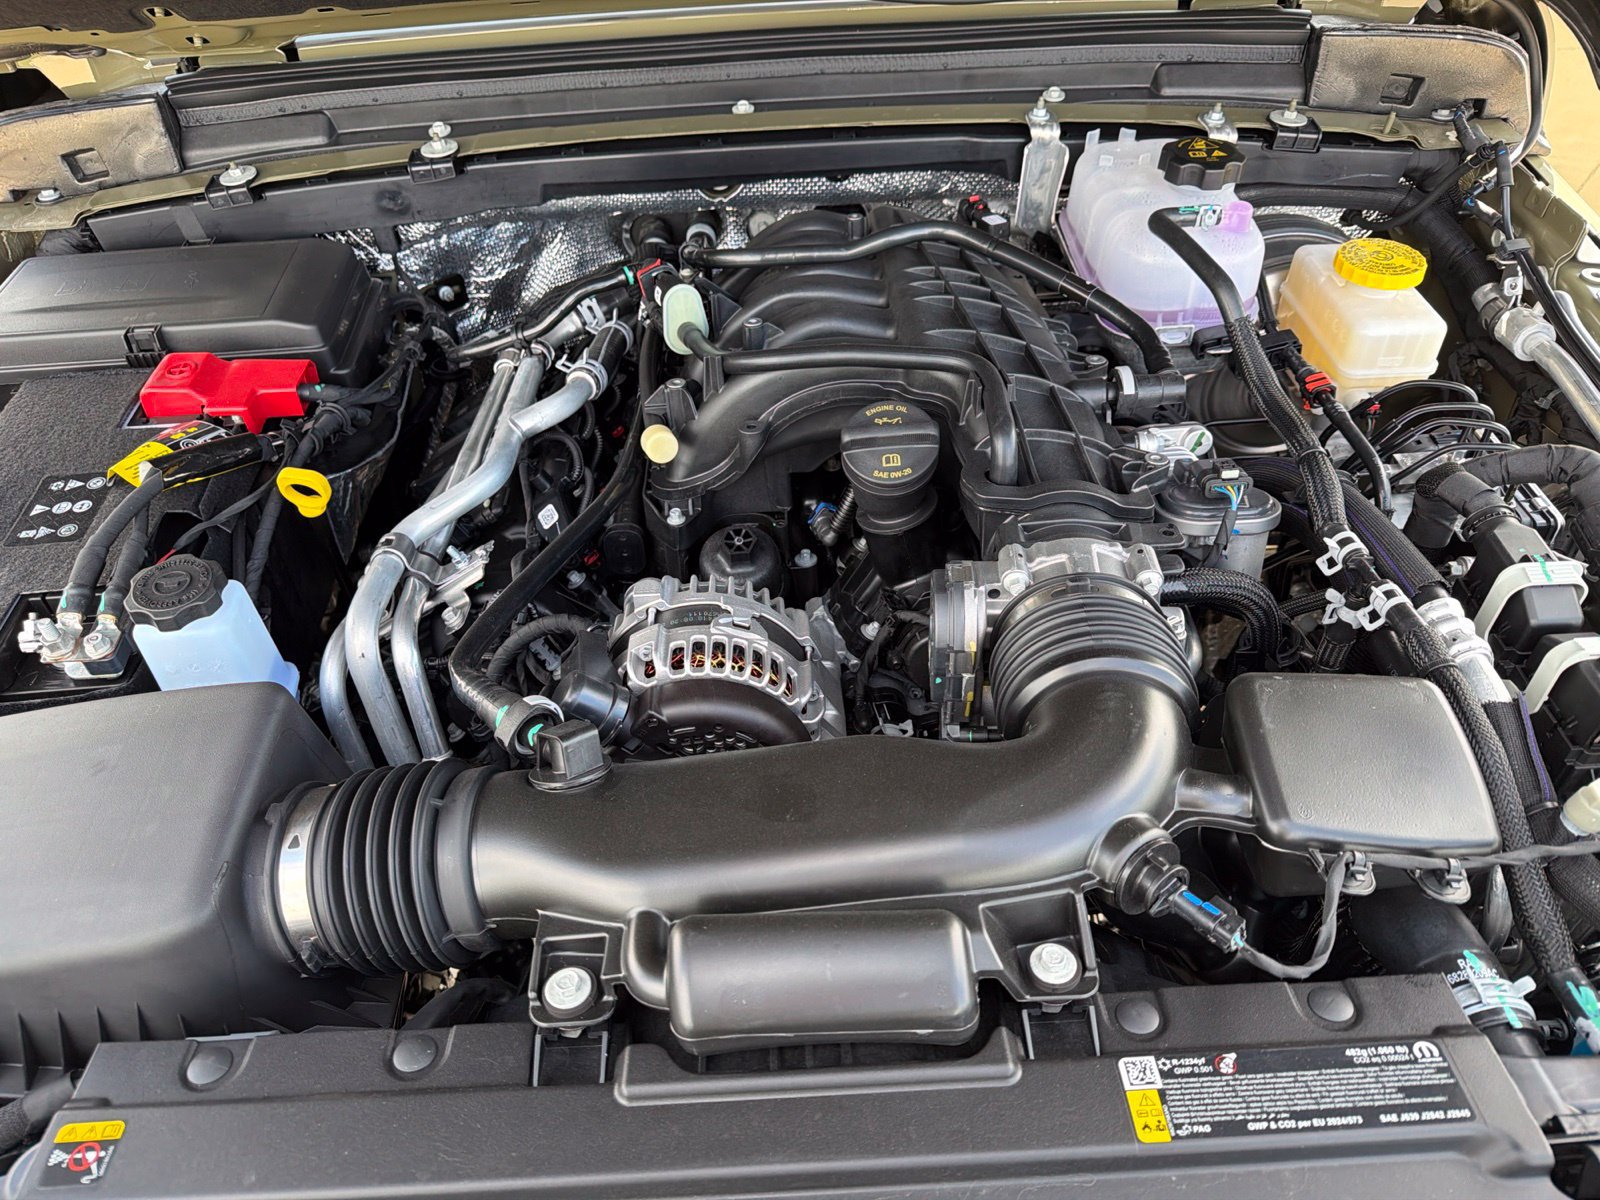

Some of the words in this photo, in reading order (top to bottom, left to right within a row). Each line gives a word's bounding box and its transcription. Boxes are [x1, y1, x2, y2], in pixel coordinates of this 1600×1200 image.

[865, 404, 894, 417] ENGINE
[895, 404, 908, 413] OIL
[873, 470, 889, 478] SAE
[889, 467, 912, 478] 0W-20
[1379, 1112, 1399, 1123] SAE
[1192, 1125, 1212, 1133] PAG
[1247, 1121, 1268, 1131] GWP
[1277, 1119, 1297, 1129] CO2
[1312, 1117, 1326, 1127] EU
